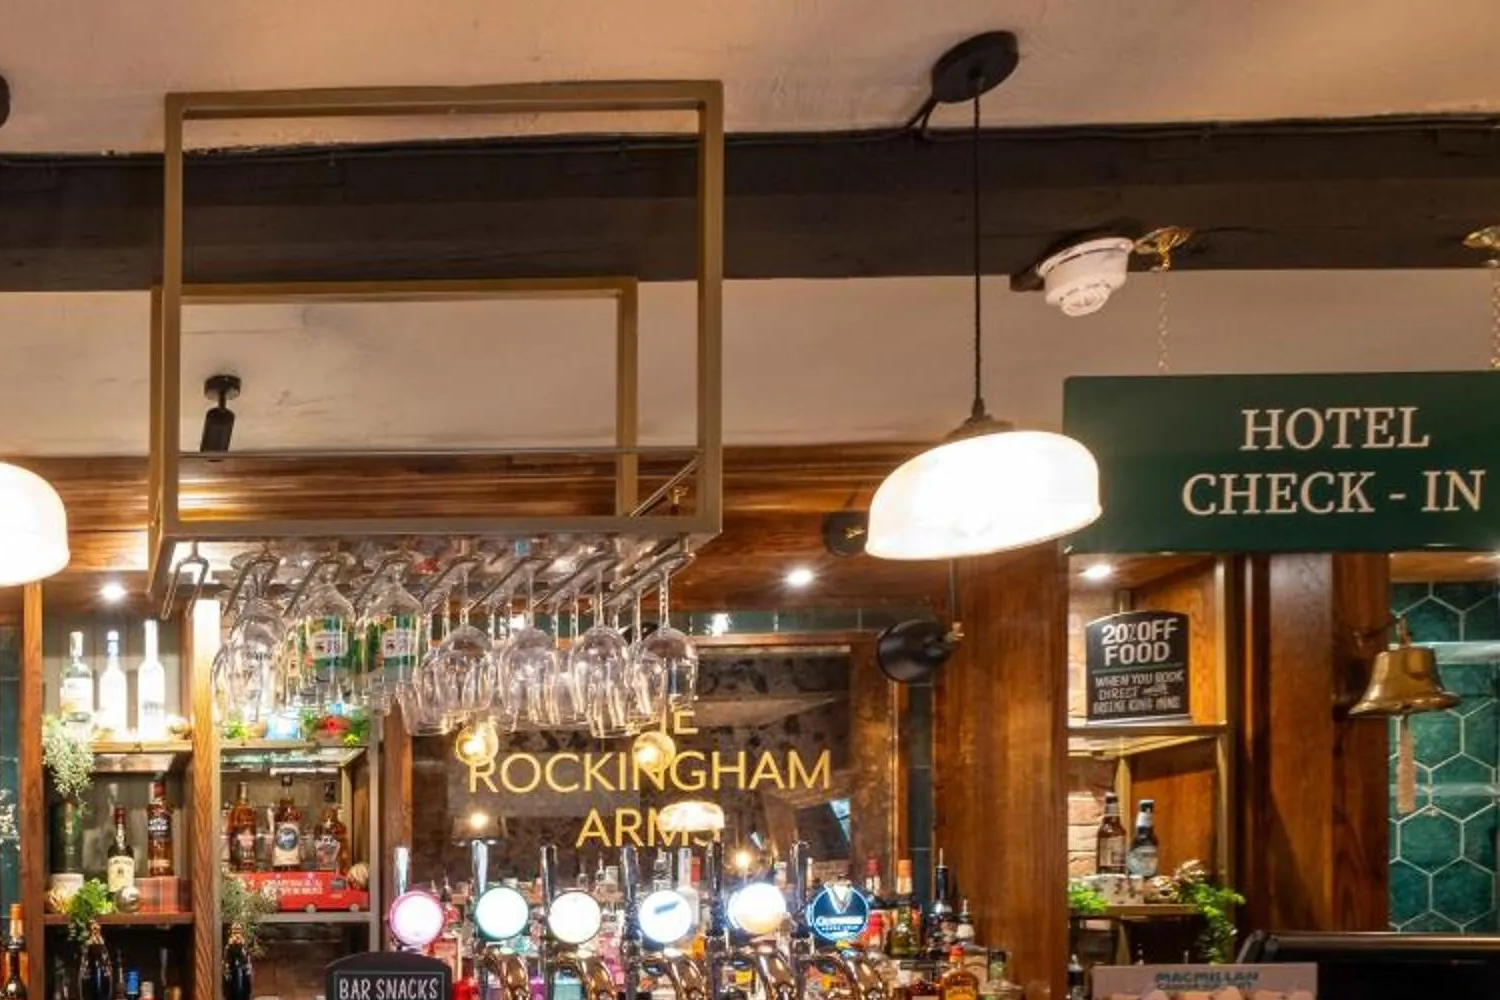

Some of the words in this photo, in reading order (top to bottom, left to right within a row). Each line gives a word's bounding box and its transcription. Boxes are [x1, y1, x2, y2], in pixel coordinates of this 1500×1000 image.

[1239, 407, 1430, 451] HOTEL
[1182, 471, 1376, 516] CHECK
[1421, 469, 1486, 512] IN
[1104, 641, 1170, 667] FOOD
[1131, 672, 1153, 685] YOU
[1099, 687, 1139, 701] DIRECT
[575, 808, 721, 848] ARM
[339, 978, 371, 1000] BAR
[376, 977, 438, 1000] SNACKS
